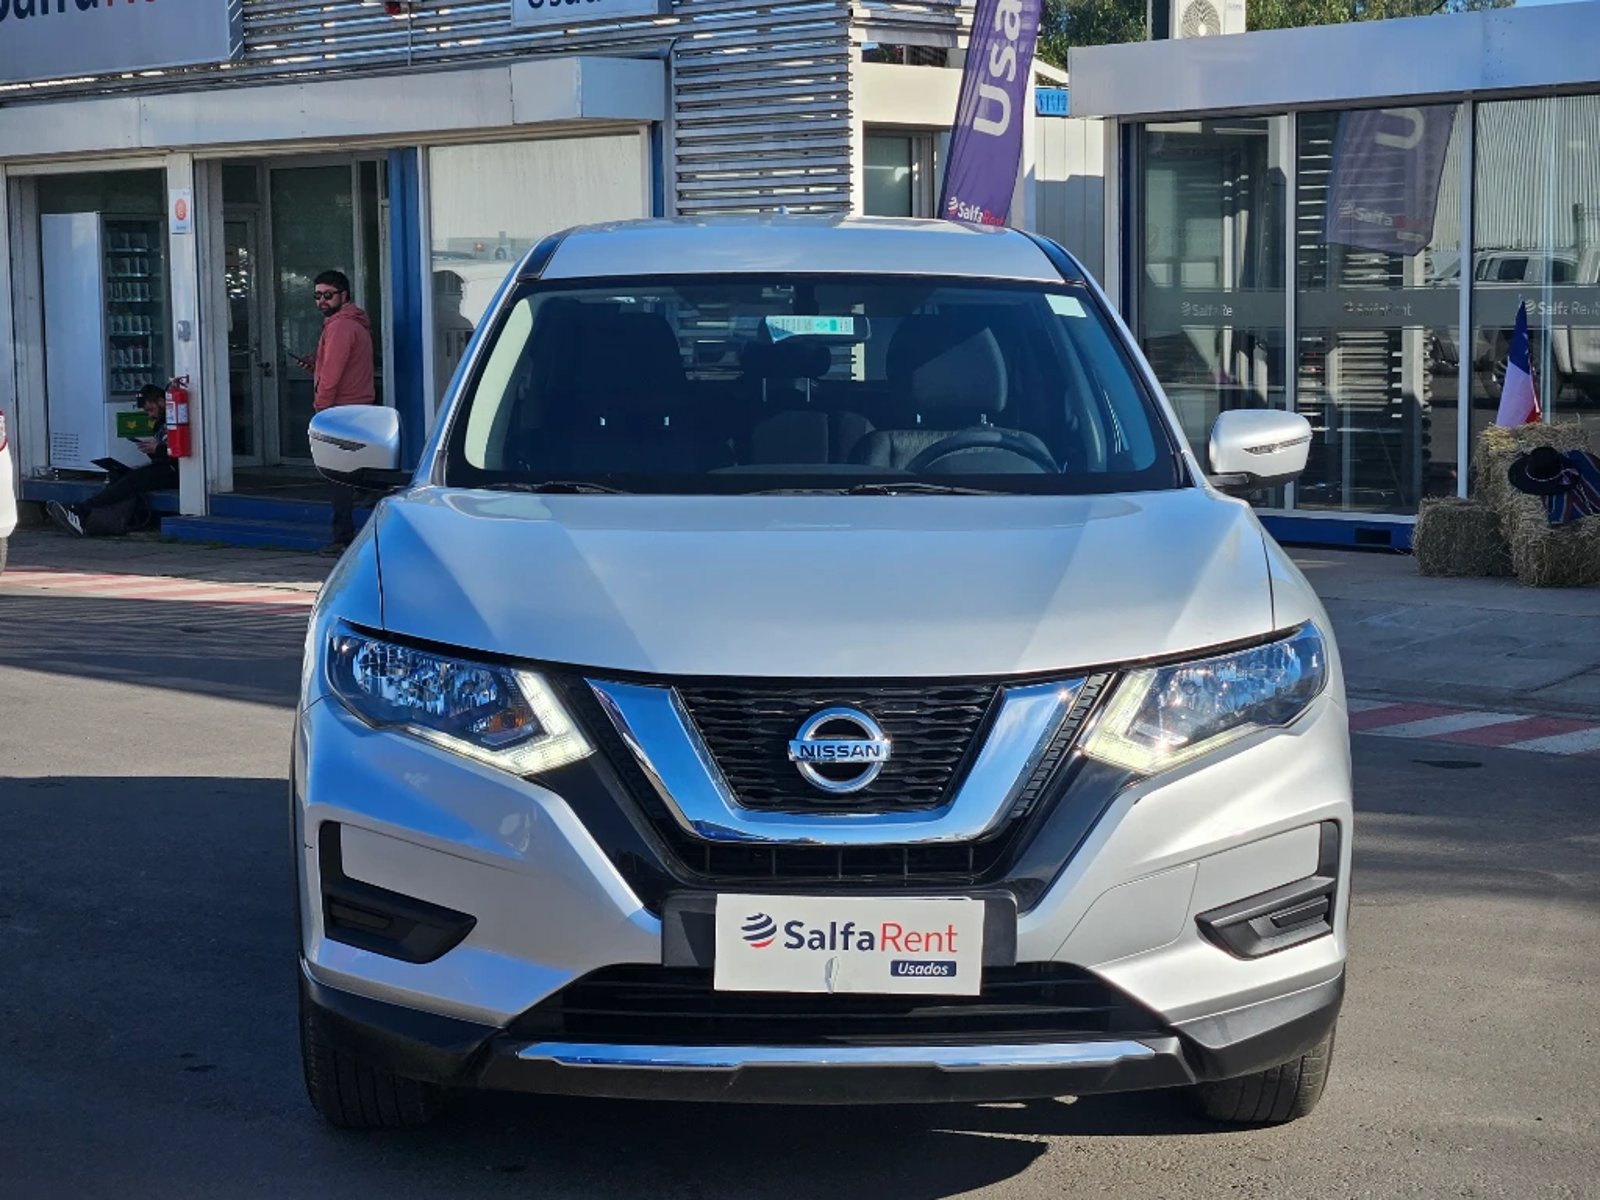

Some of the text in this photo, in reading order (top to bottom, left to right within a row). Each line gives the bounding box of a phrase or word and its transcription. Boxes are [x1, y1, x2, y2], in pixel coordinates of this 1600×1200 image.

[799, 744, 881, 759] NISSAN
[783, 920, 958, 953] SalfaRent
[897, 962, 949, 977] Usados
